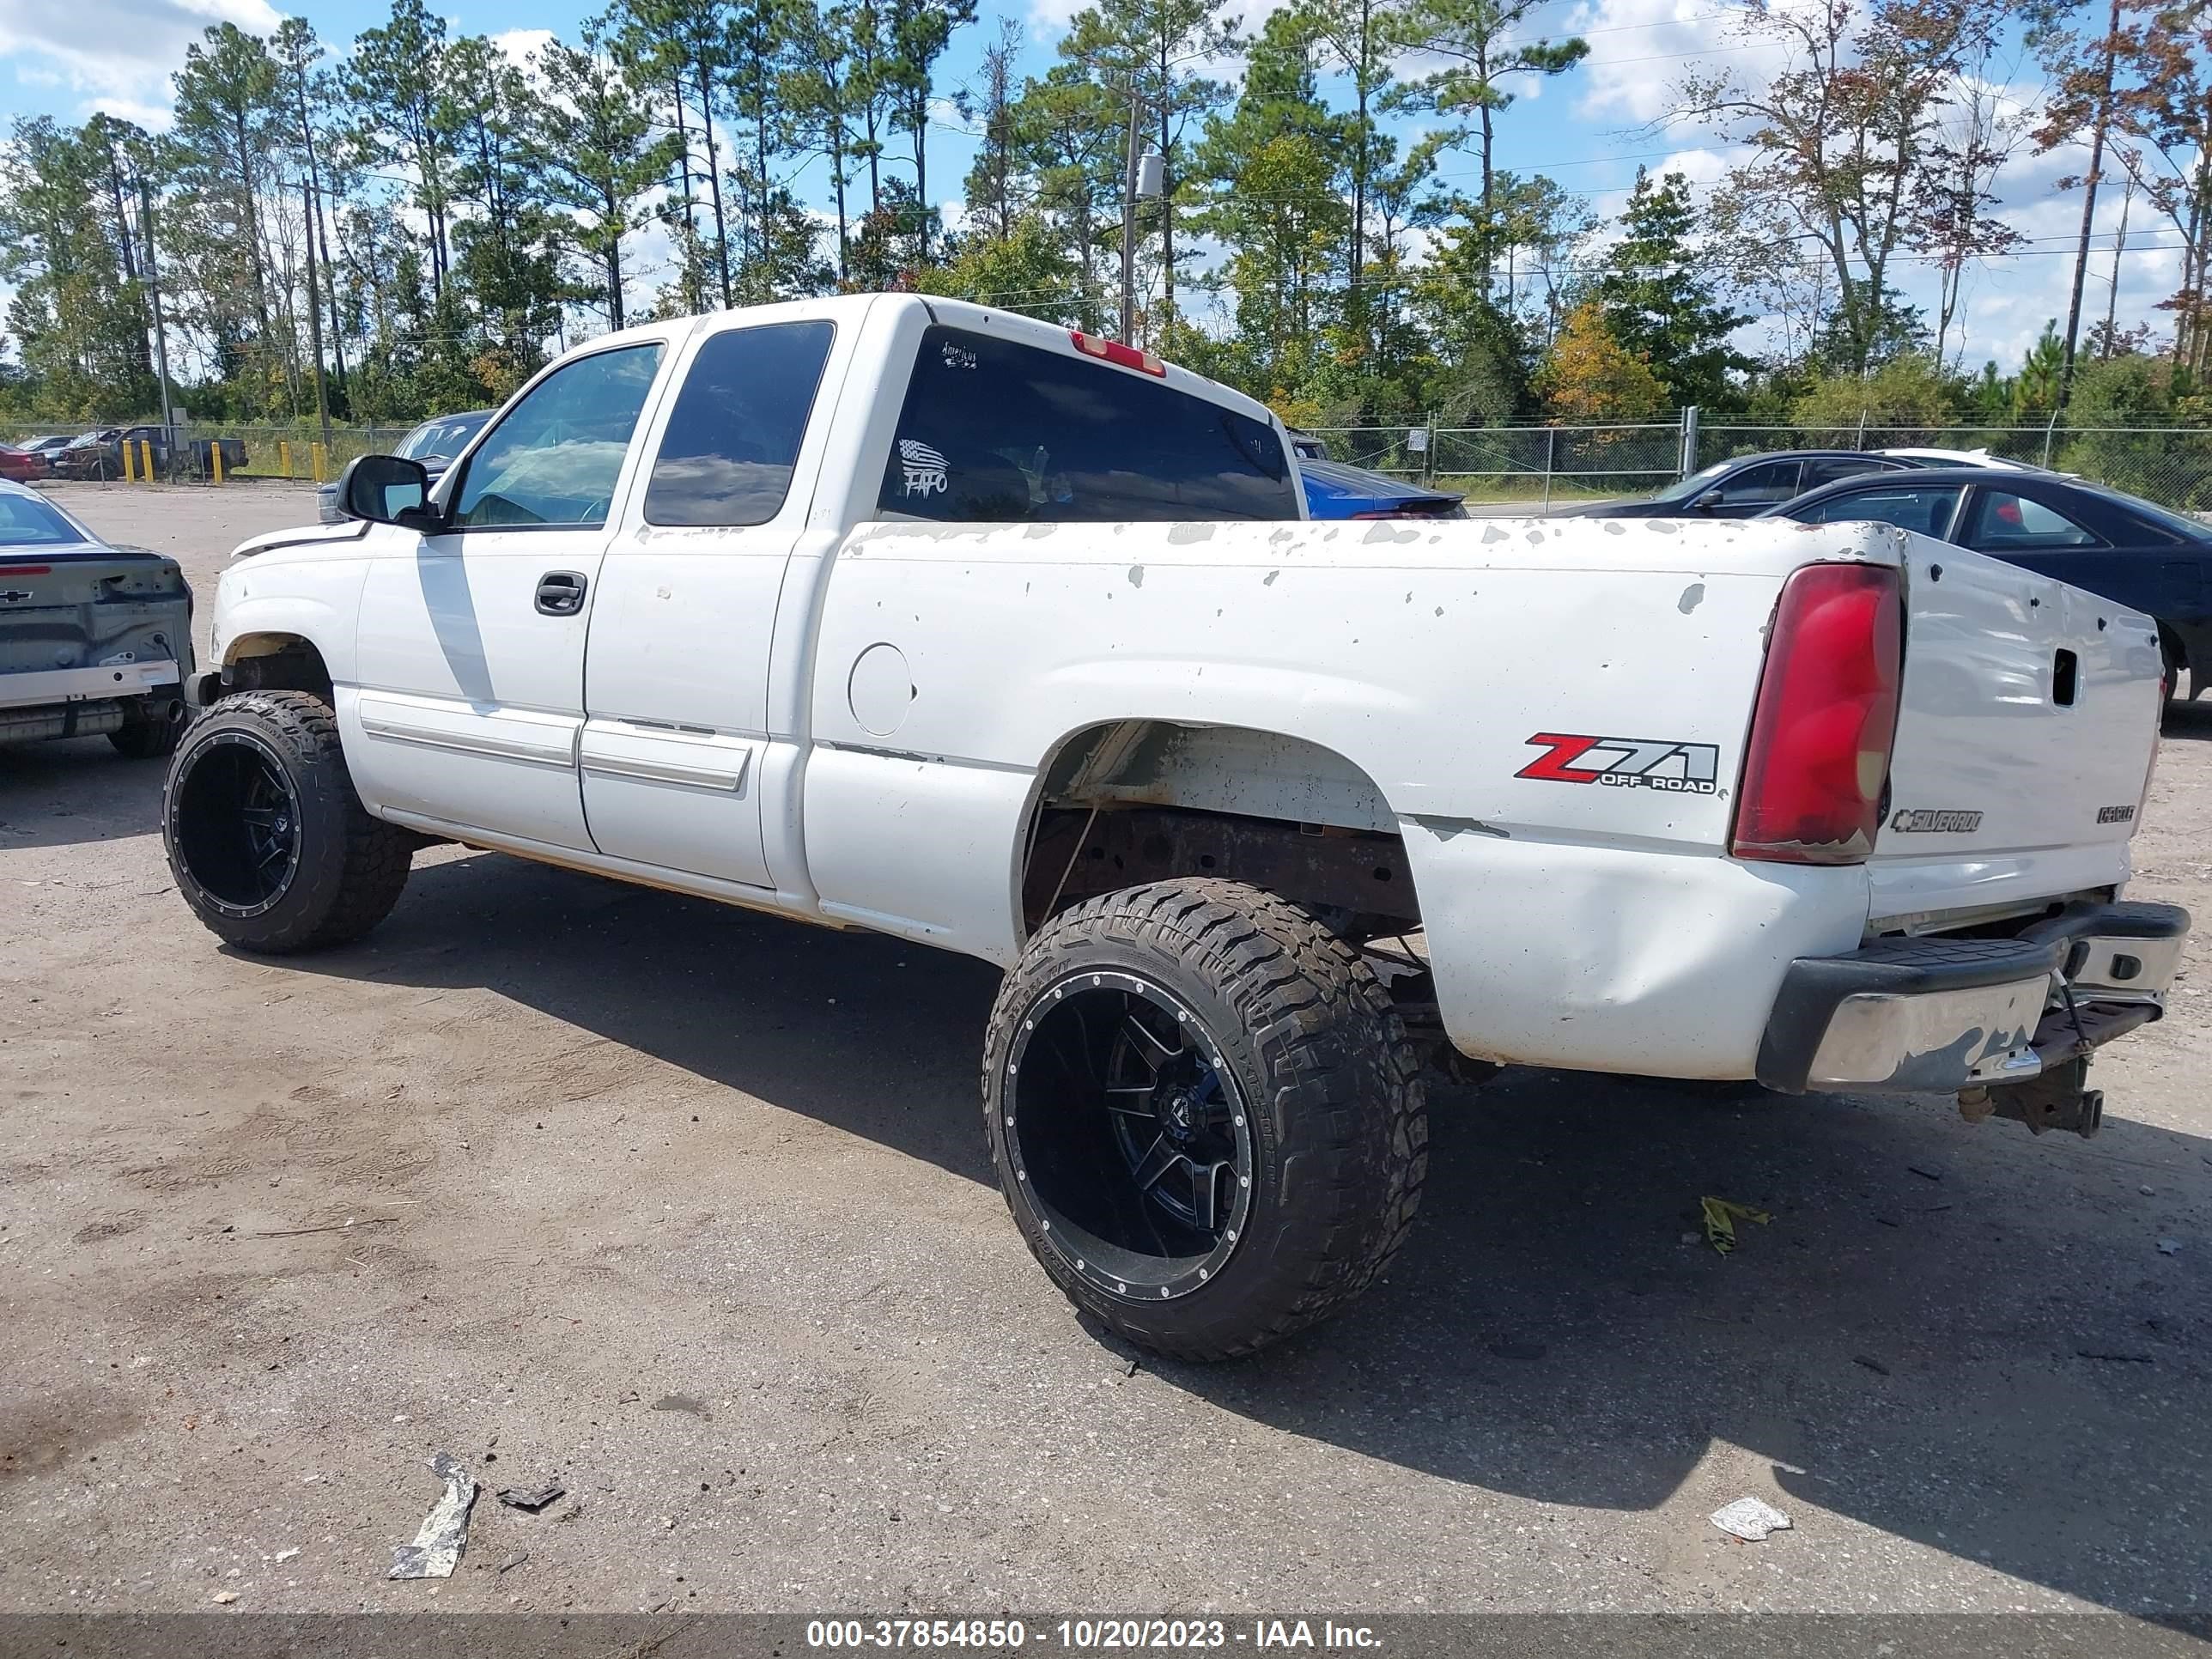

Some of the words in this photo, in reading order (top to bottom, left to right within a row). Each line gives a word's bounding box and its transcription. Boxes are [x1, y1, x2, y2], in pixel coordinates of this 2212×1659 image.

[1513, 732, 1720, 784] Z71
[1600, 773, 1643, 787] OFF
[1652, 778, 1715, 793] ROAD
[1909, 810, 1984, 832] SILVERADO
